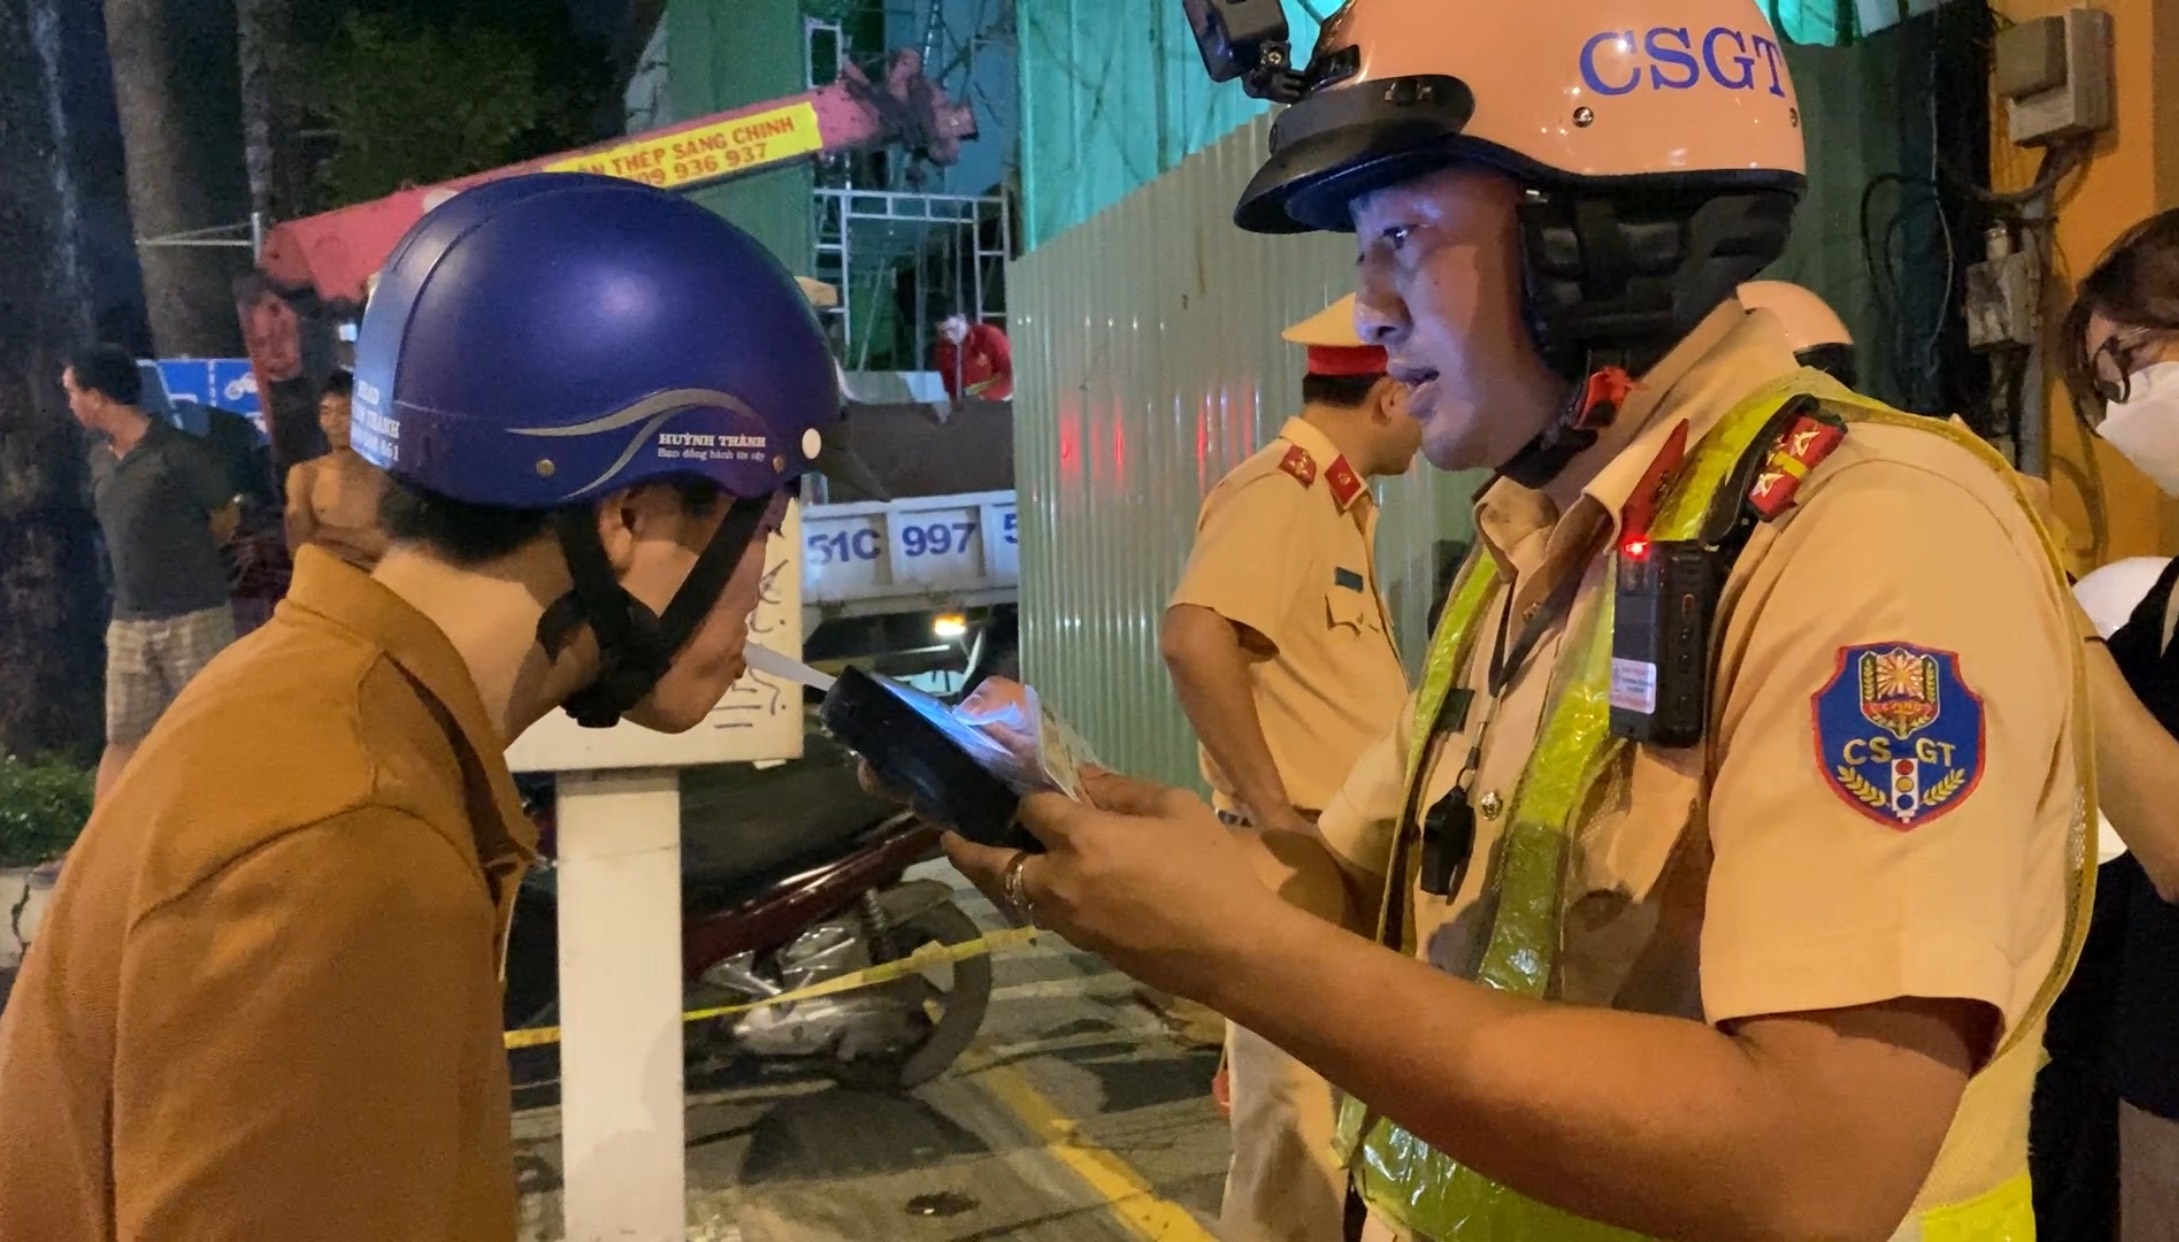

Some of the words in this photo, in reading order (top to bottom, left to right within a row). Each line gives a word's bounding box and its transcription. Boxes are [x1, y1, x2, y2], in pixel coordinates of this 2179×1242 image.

[1578, 26, 1786, 98] CSGT
[674, 154, 719, 180] 936
[725, 142, 767, 167] 937
[807, 528, 881, 566] 51C
[902, 522, 977, 558] 997
[1842, 736, 1892, 766] CS
[1915, 737, 1957, 768] GT
